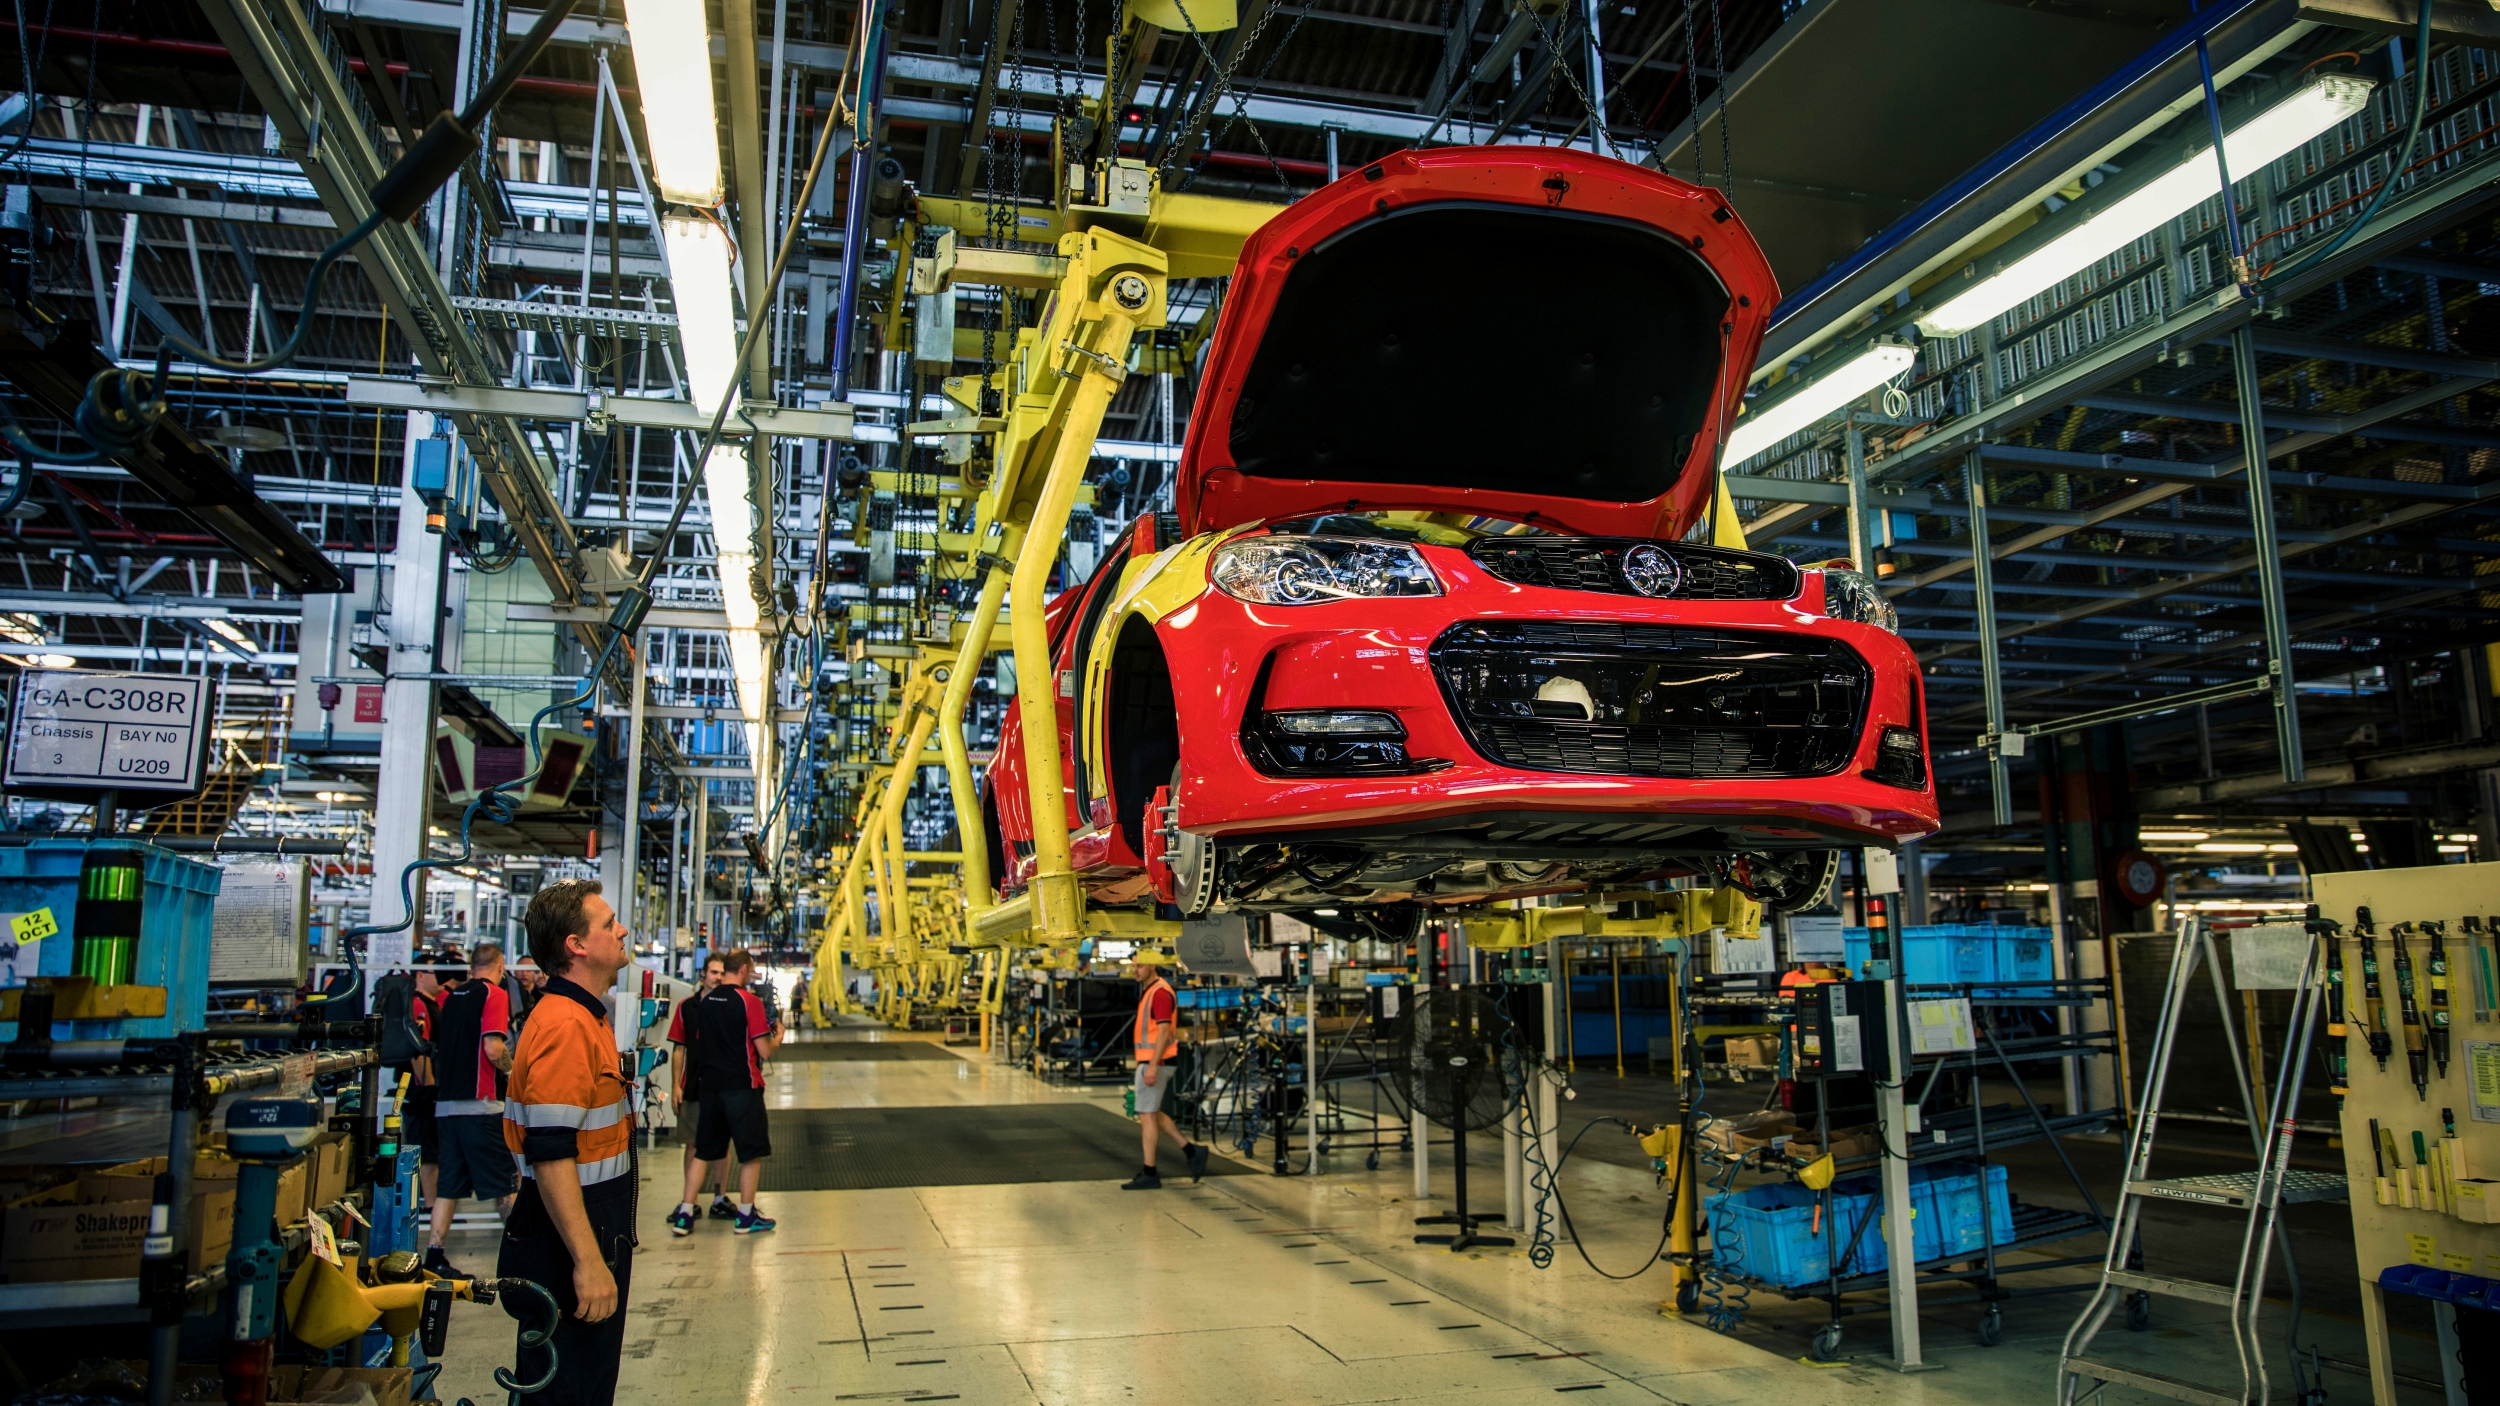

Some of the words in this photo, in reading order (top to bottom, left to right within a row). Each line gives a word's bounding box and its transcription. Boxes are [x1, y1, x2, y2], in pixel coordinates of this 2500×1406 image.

[984, 210, 1012, 227] 42
[33, 687, 186, 714] GA-C308R
[365, 699, 372, 709] 3
[31, 725, 94, 739] Chassis
[119, 729, 151, 742] BAY
[53, 753, 63, 764] 3
[119, 758, 170, 774] U209
[23, 913, 42, 927] 12
[19, 922, 51, 941] OCT
[75, 1213, 151, 1234] Shakepr
[427, 1317, 435, 1331] 18V
